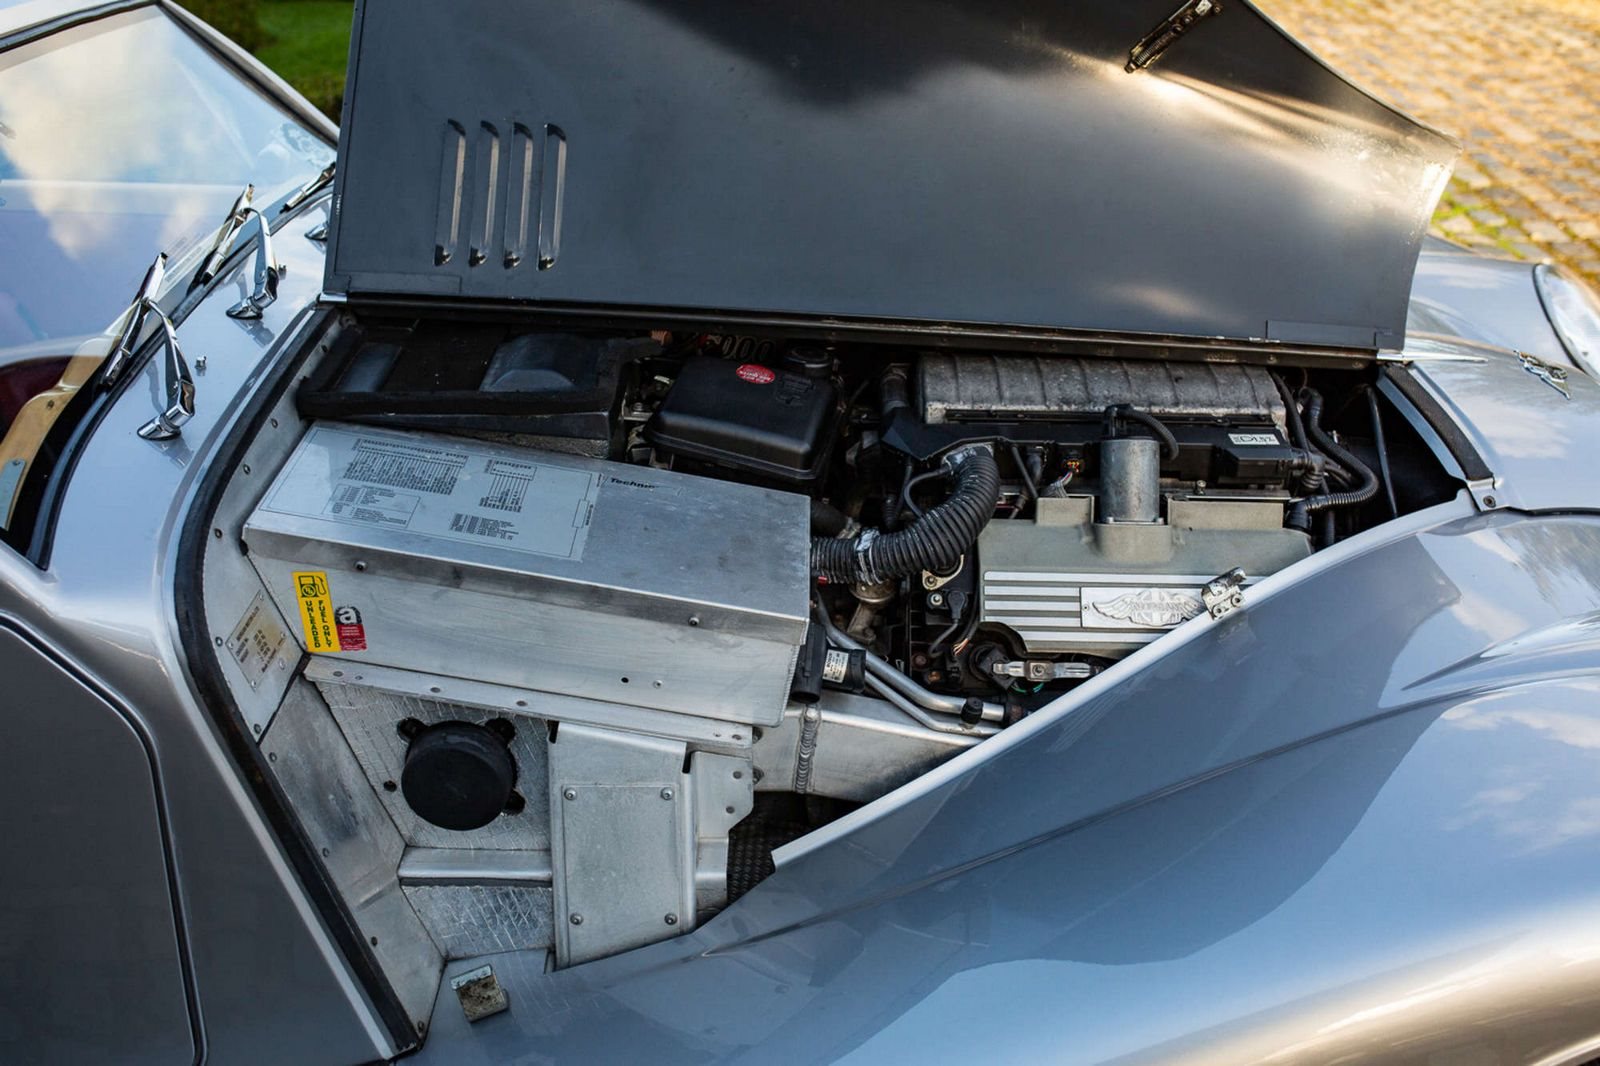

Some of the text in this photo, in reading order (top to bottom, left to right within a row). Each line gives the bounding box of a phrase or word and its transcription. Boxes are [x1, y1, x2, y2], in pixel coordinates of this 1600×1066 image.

[305, 600, 321, 648] UNLEADED
[318, 600, 333, 648] FUEL ONLY
